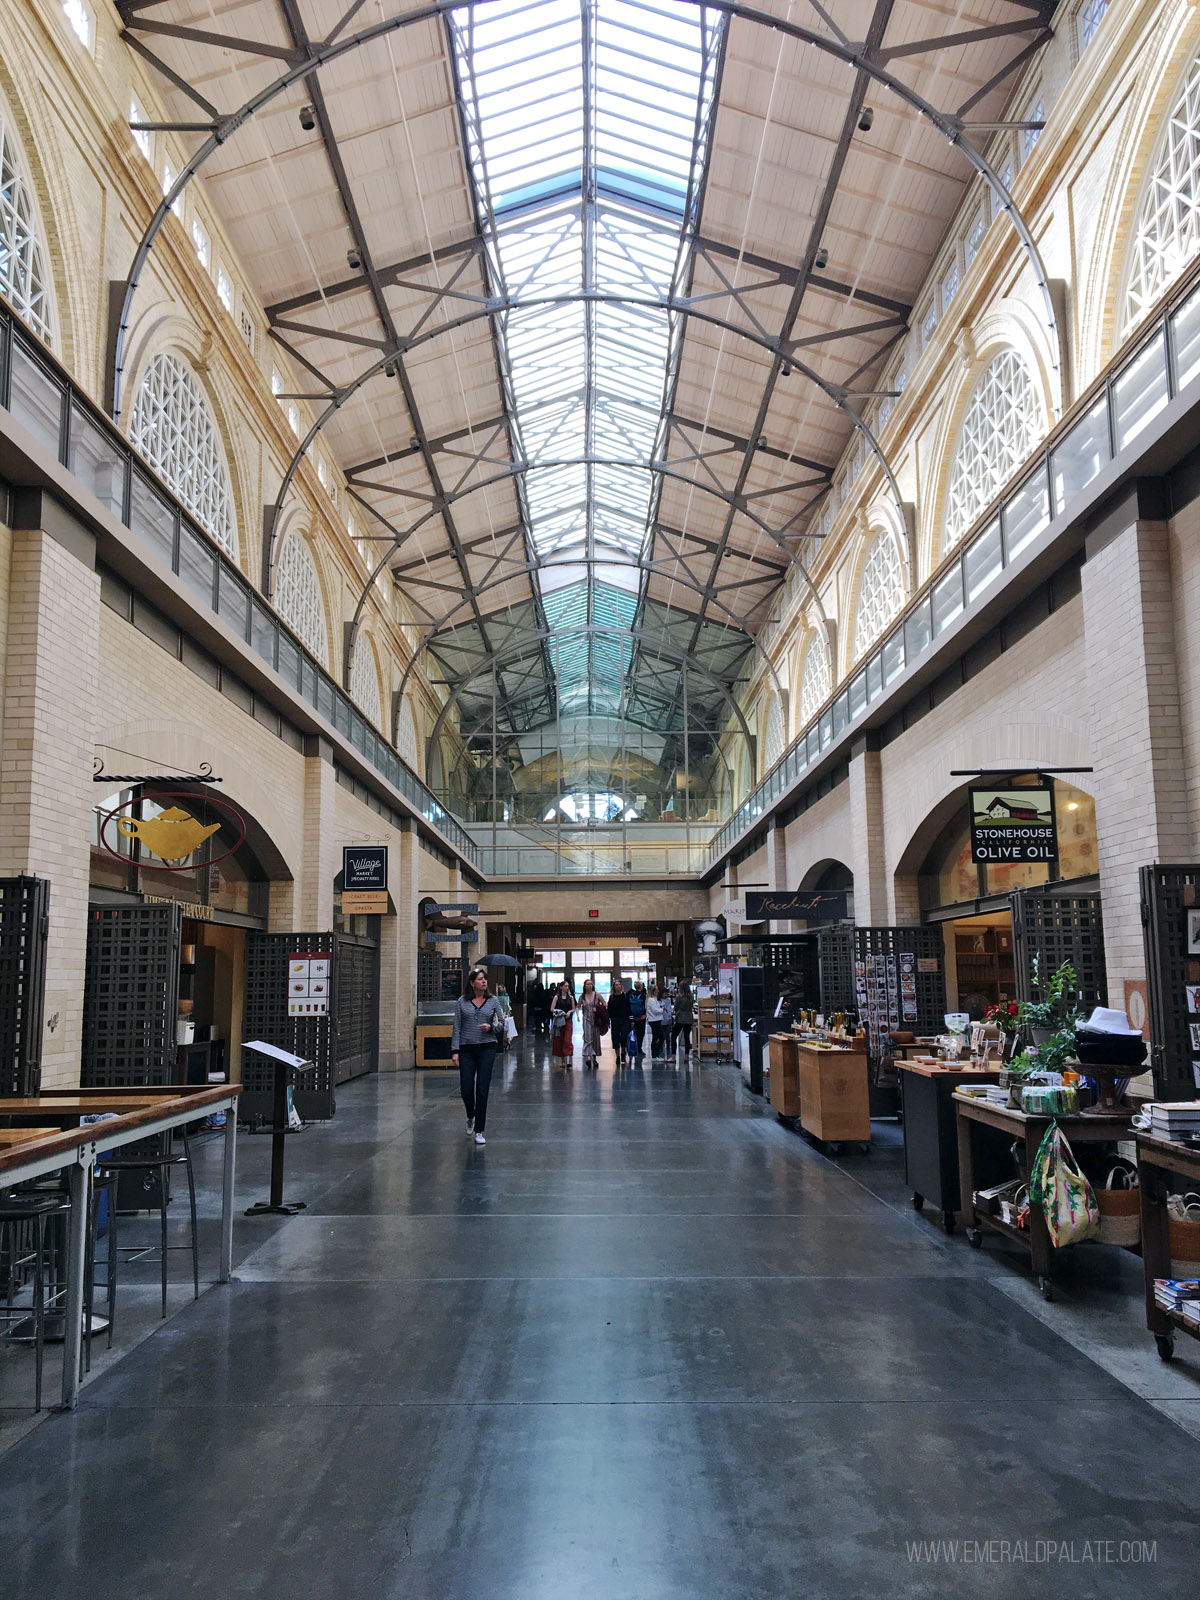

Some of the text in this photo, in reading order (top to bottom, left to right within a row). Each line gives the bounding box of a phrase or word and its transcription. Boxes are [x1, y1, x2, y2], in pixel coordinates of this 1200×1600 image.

[975, 828, 1053, 838] STONEHOUSE
[976, 846, 1054, 858] OLIVE OIL
[349, 858, 382, 871] Village
